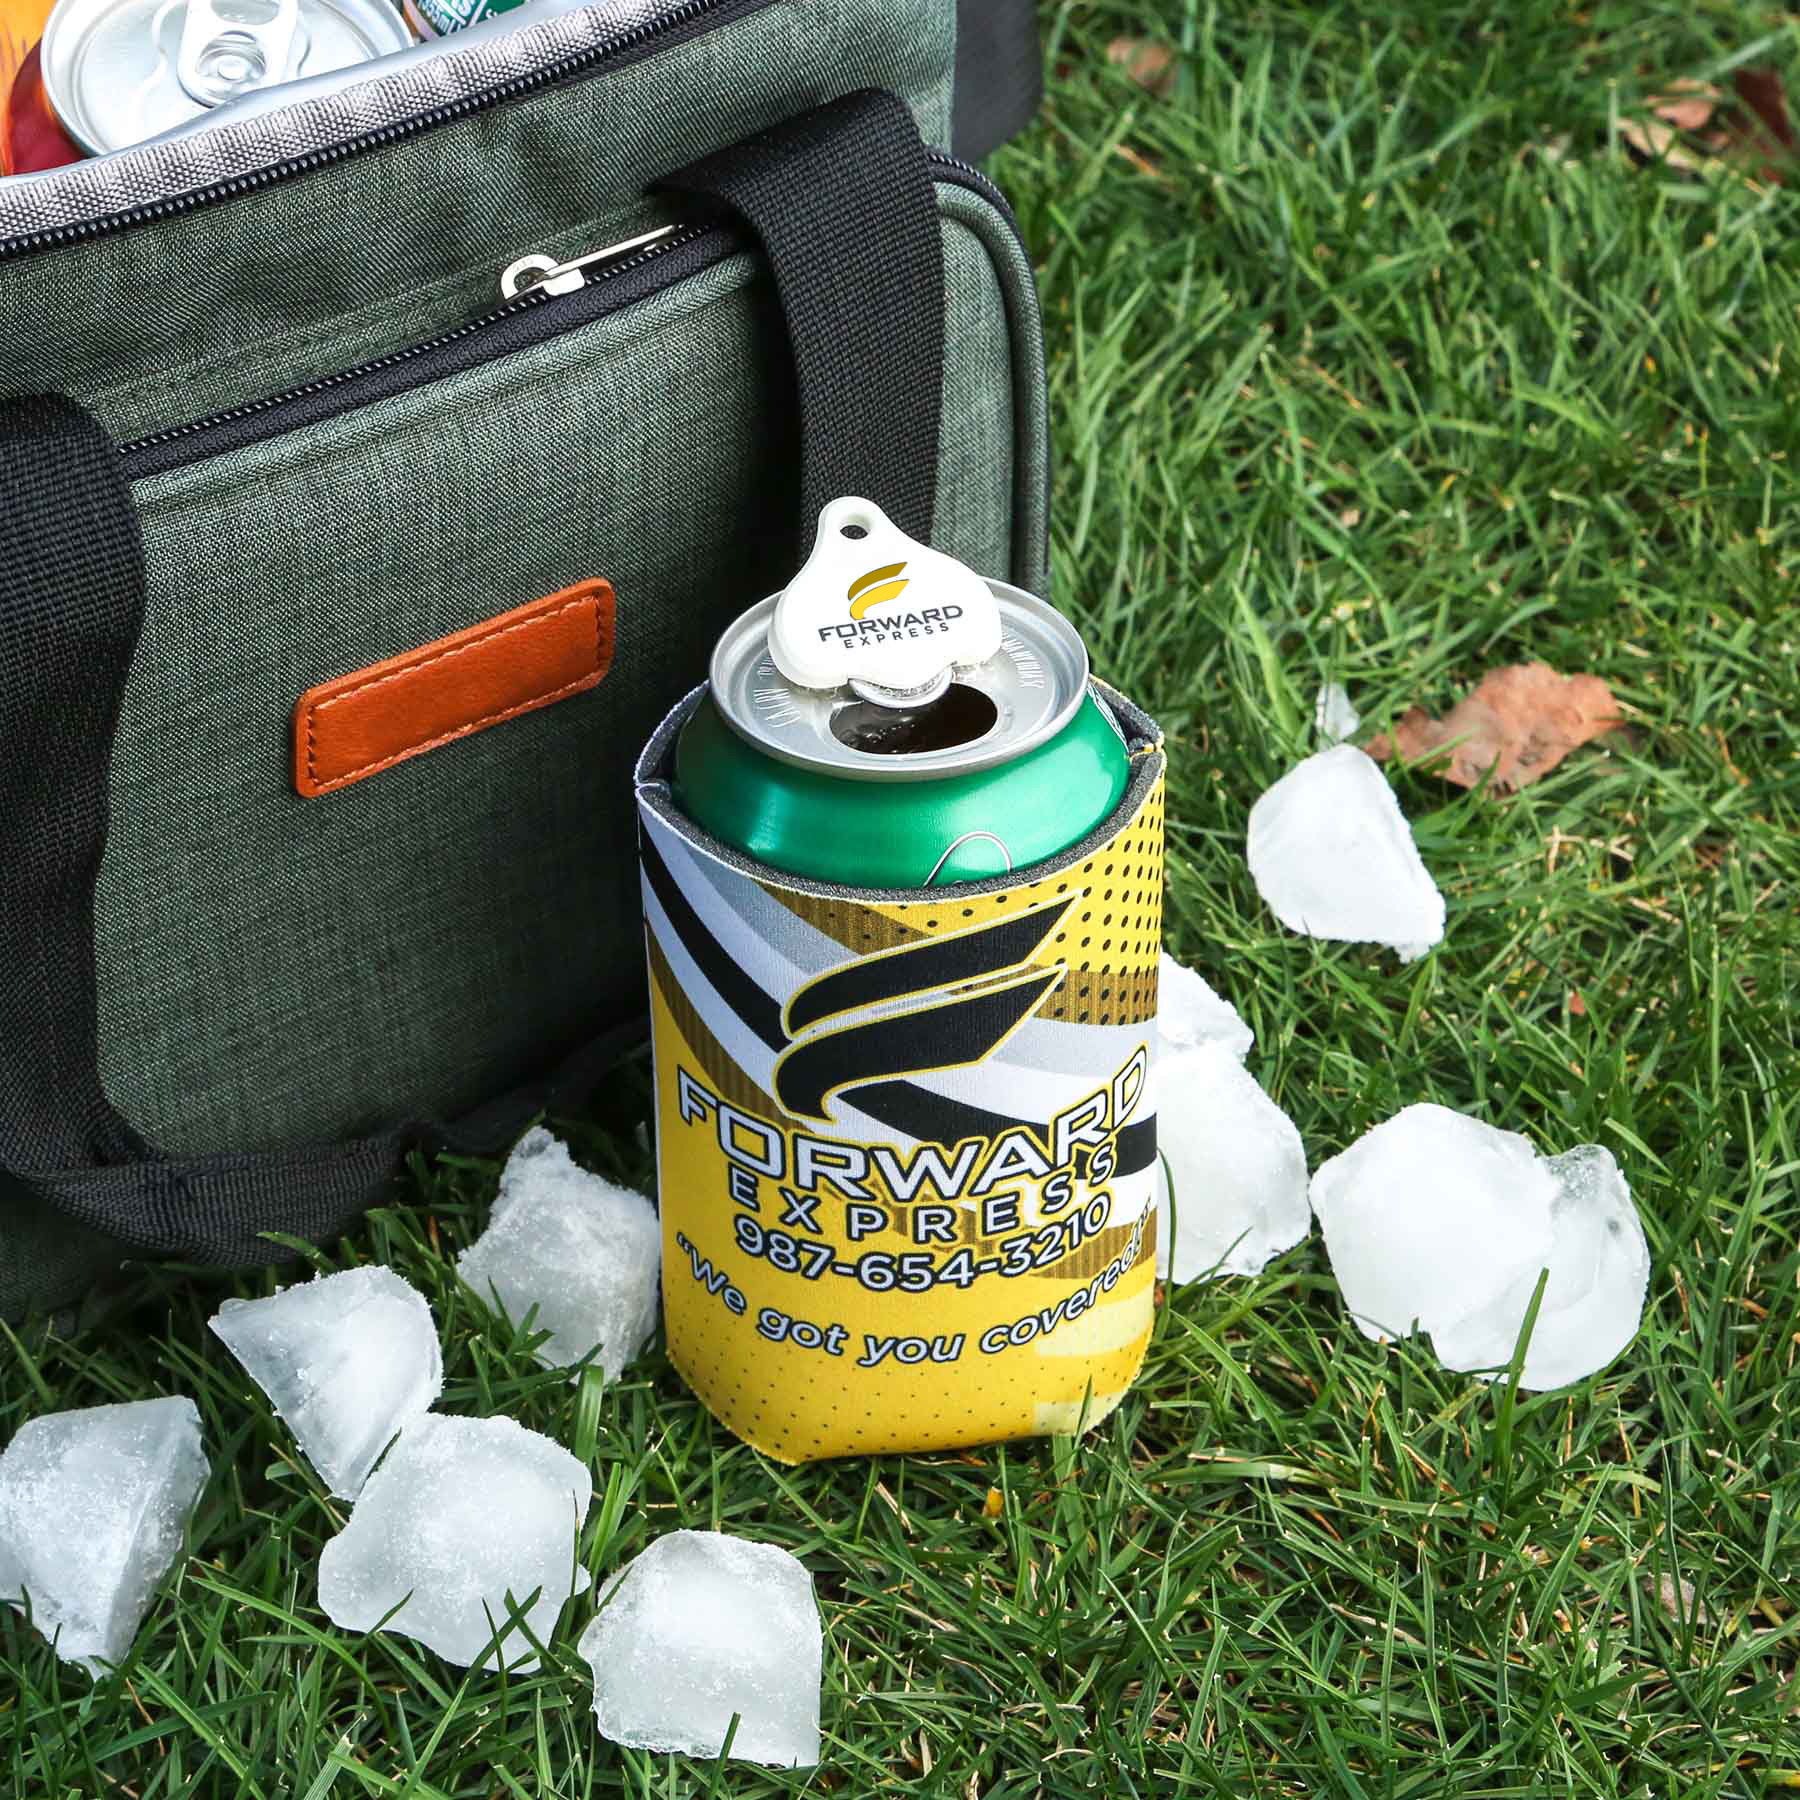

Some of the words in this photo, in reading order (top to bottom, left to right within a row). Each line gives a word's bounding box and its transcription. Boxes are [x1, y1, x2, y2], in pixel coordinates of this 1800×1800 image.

[817, 604, 963, 642] FORWARD
[843, 622, 949, 649] EXPRESS
[677, 1045, 1147, 1200] FORWARD
[728, 1142, 1114, 1244] EXPRESS
[733, 1191, 1111, 1292] 987-654-3210
[755, 1307, 849, 1356] got
[856, 1333, 966, 1367] you
